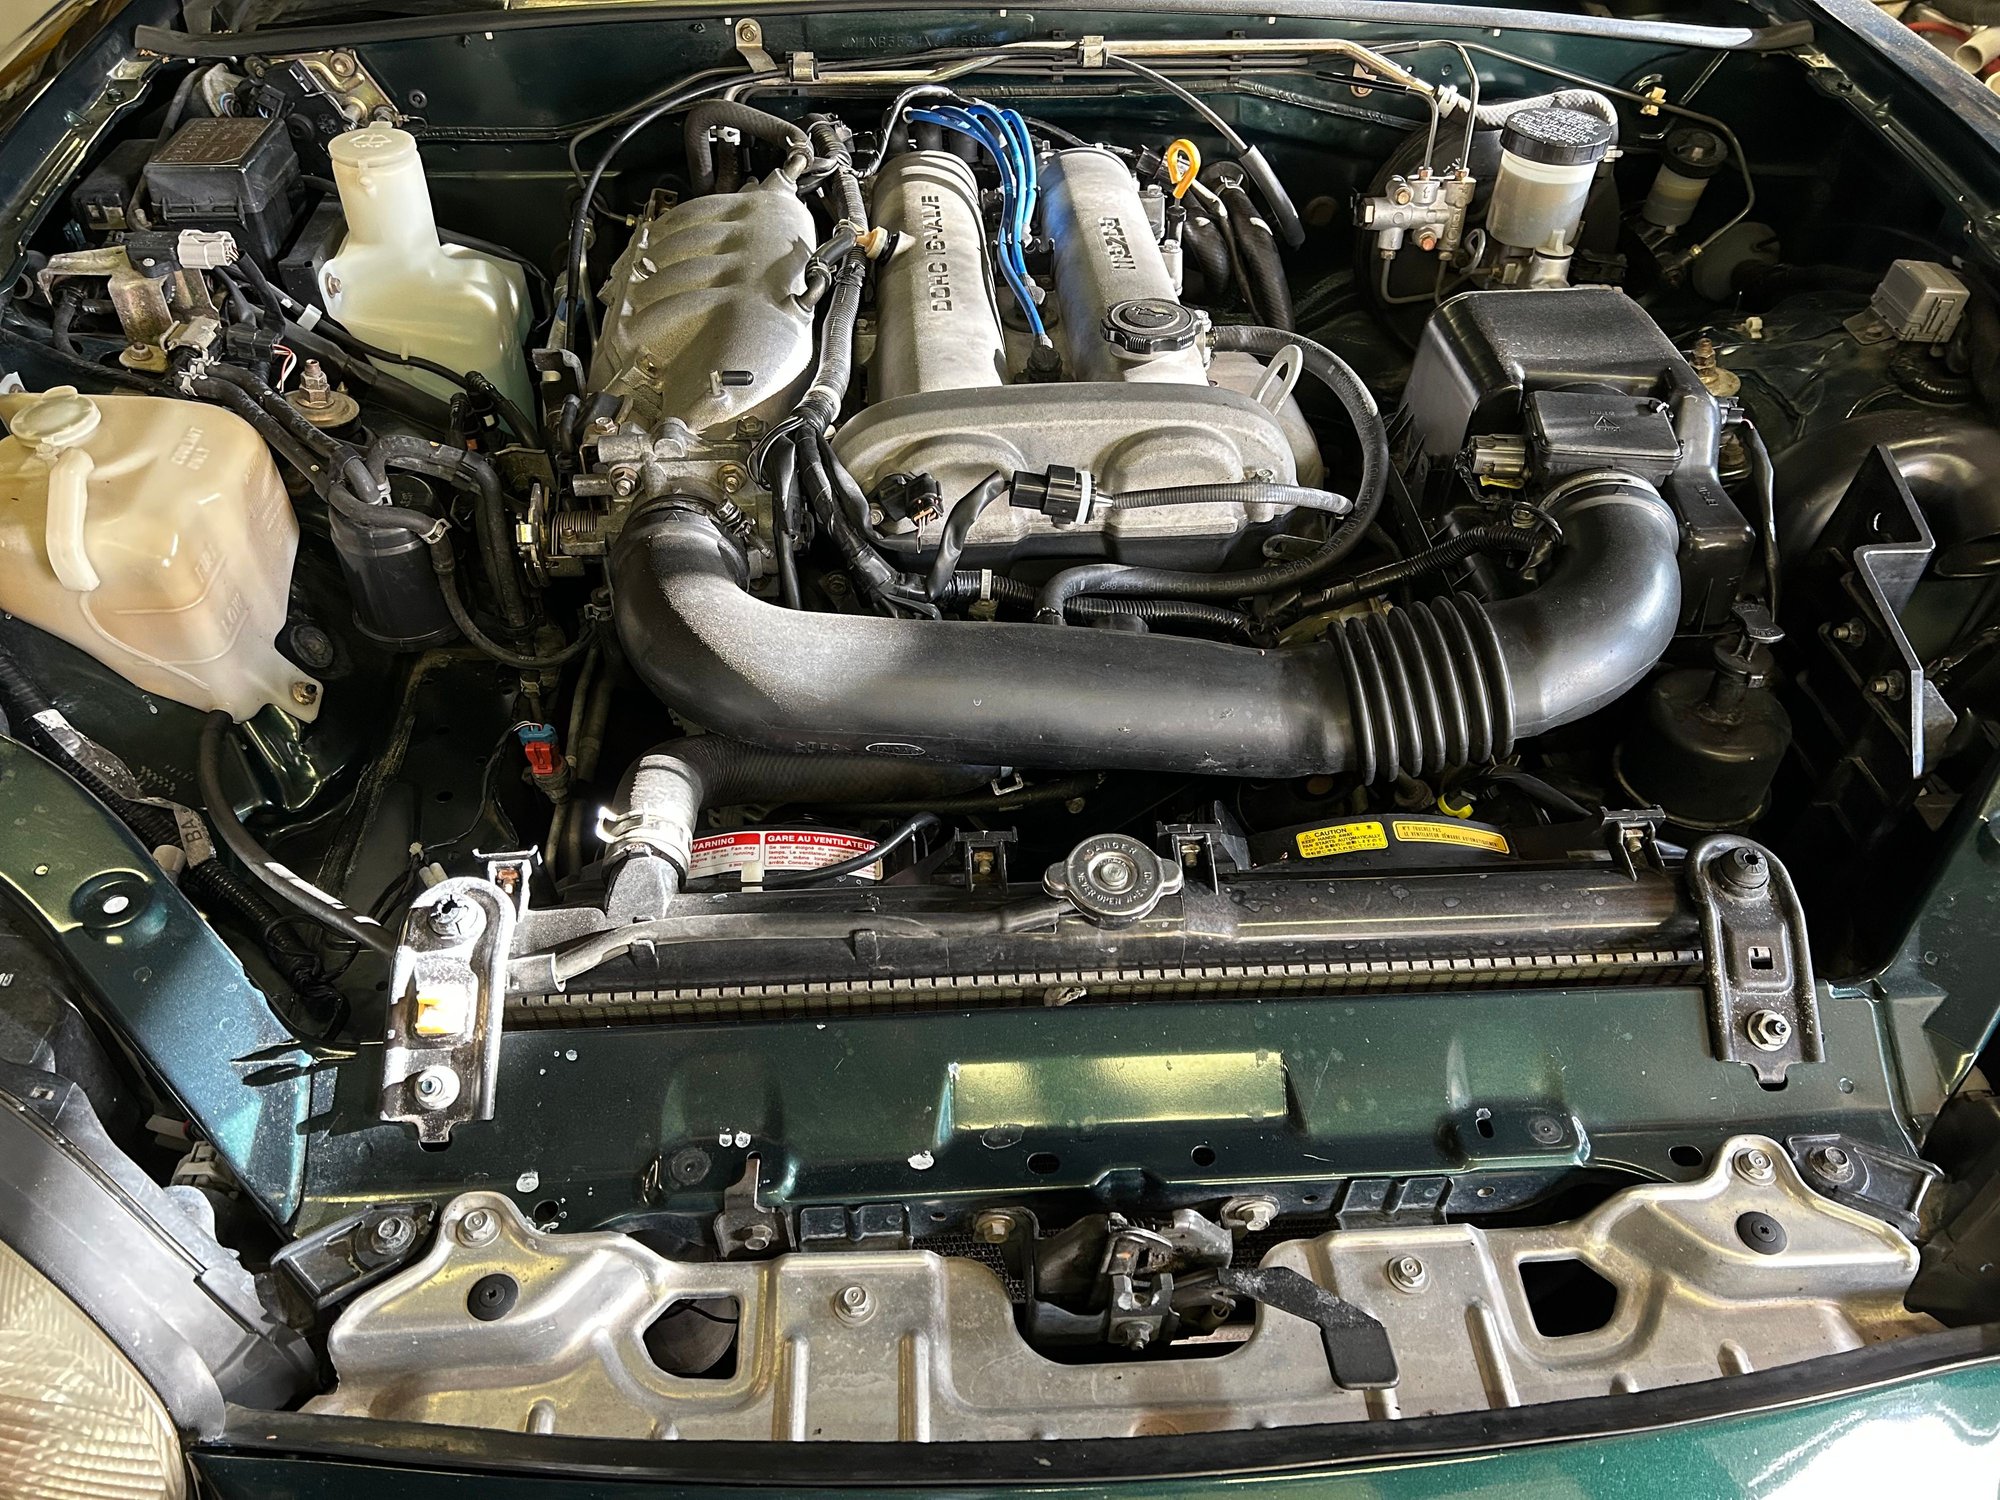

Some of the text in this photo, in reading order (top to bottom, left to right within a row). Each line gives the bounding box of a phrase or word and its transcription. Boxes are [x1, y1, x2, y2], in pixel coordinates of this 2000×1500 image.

[926, 261, 953, 312] DOHC
[1342, 486, 1375, 535] EMISSION
[1317, 537, 1345, 560] FUEL
[1252, 557, 1313, 586] INJECTION
[1169, 582, 1190, 594] USA
[1196, 582, 1211, 593] IN
[1218, 578, 1247, 592] MADE
[1314, 827, 1347, 838] CAUTION
[1315, 839, 1336, 847] STARTS
[1338, 833, 1381, 843] AUTOMATICALLY
[767, 834, 876, 851] GARE AU VENTILATEUR
[1086, 842, 1137, 856] DANGER
[1077, 872, 1097, 897] NEVER
[1097, 895, 1122, 906] OPEN
